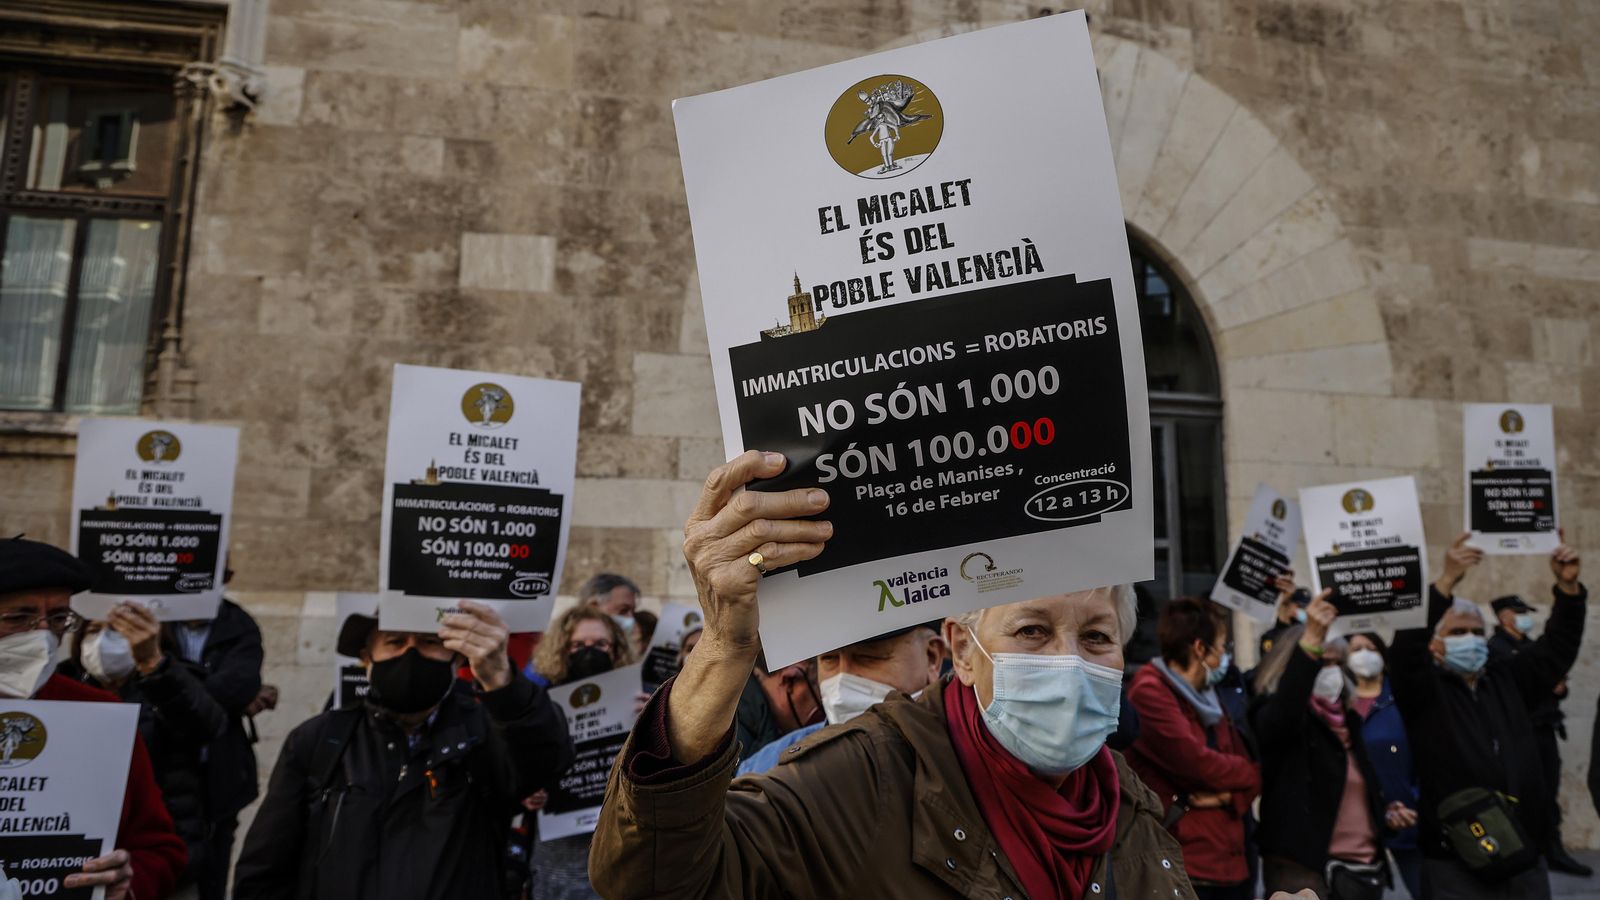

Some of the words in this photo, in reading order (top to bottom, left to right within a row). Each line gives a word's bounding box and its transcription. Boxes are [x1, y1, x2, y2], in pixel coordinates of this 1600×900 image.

[818, 205, 850, 235] EL
[857, 178, 971, 226] MICALET
[859, 229, 895, 264] ÉS
[904, 222, 955, 255] DEL
[812, 271, 895, 312] POBLE
[903, 238, 1044, 294] VALENCIÀ
[742, 341, 956, 397] IMMATRICULACIONS
[797, 398, 855, 437] NO
[864, 381, 947, 426] SÓN
[957, 365, 1060, 409] 1.000
[449, 432, 463, 446] EL
[467, 433, 519, 450] MICALET
[815, 442, 897, 484] SÓN
[907, 417, 1055, 468] 100.000
[464, 449, 480, 464] ÉS
[484, 452, 506, 466] DEL
[438, 466, 476, 481] POBLE
[481, 469, 540, 486] VALENCIÀ
[1034, 462, 1116, 486] Concentració
[855, 480, 906, 500] Plaça
[910, 473, 934, 491] de
[395, 498, 495, 513] IMMATRICULACIONS
[885, 502, 908, 518] 16
[912, 496, 935, 513] de
[940, 487, 1000, 509] Febrer
[1034, 497, 1057, 513] 12
[1062, 496, 1074, 508] a
[1079, 490, 1102, 506] 13
[1106, 485, 1119, 501] h
[418, 516, 446, 533] NO
[449, 515, 487, 534] SÓN
[491, 521, 536, 537] 1.000
[100, 534, 124, 546] NO
[125, 533, 158, 547] SÓN
[421, 537, 460, 555] SÓN
[464, 541, 530, 558] 100.000
[102, 550, 135, 563] SÓN
[887, 566, 949, 588] valència
[0, 776, 49, 792] CALET
[0, 812, 71, 832] ALENCIÀ
[20, 878, 59, 896] 000
